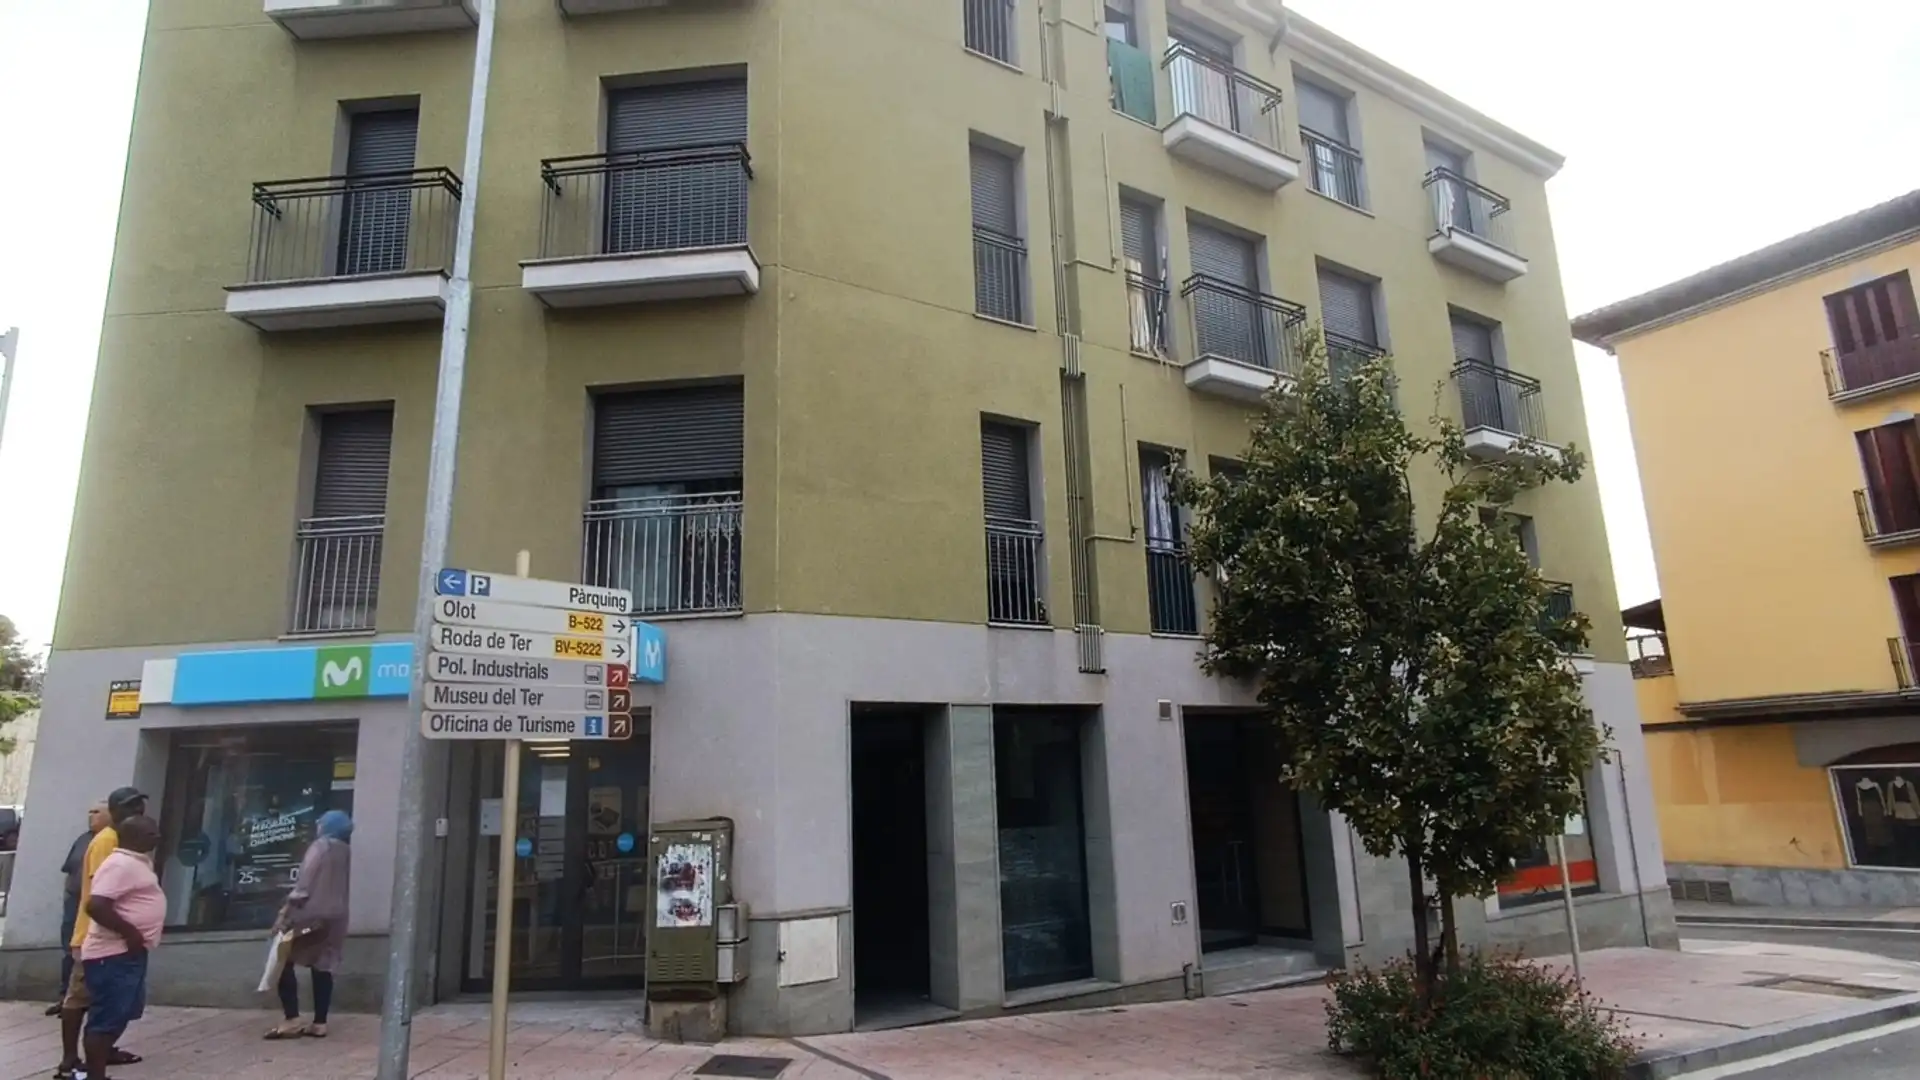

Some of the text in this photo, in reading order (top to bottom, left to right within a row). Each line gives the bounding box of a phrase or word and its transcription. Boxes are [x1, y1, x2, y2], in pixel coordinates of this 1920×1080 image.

[443, 600, 476, 619] Olot
[569, 587, 628, 612] Pàrquing
[569, 614, 604, 631] B-522
[441, 627, 532, 651] Roda de Ter
[555, 639, 602, 657] BV-5222
[377, 663, 410, 678] mo
[438, 656, 549, 680] Pol. Industrials
[433, 685, 544, 707] Museu del Ter
[430, 713, 576, 734] Oficina de Turisme
